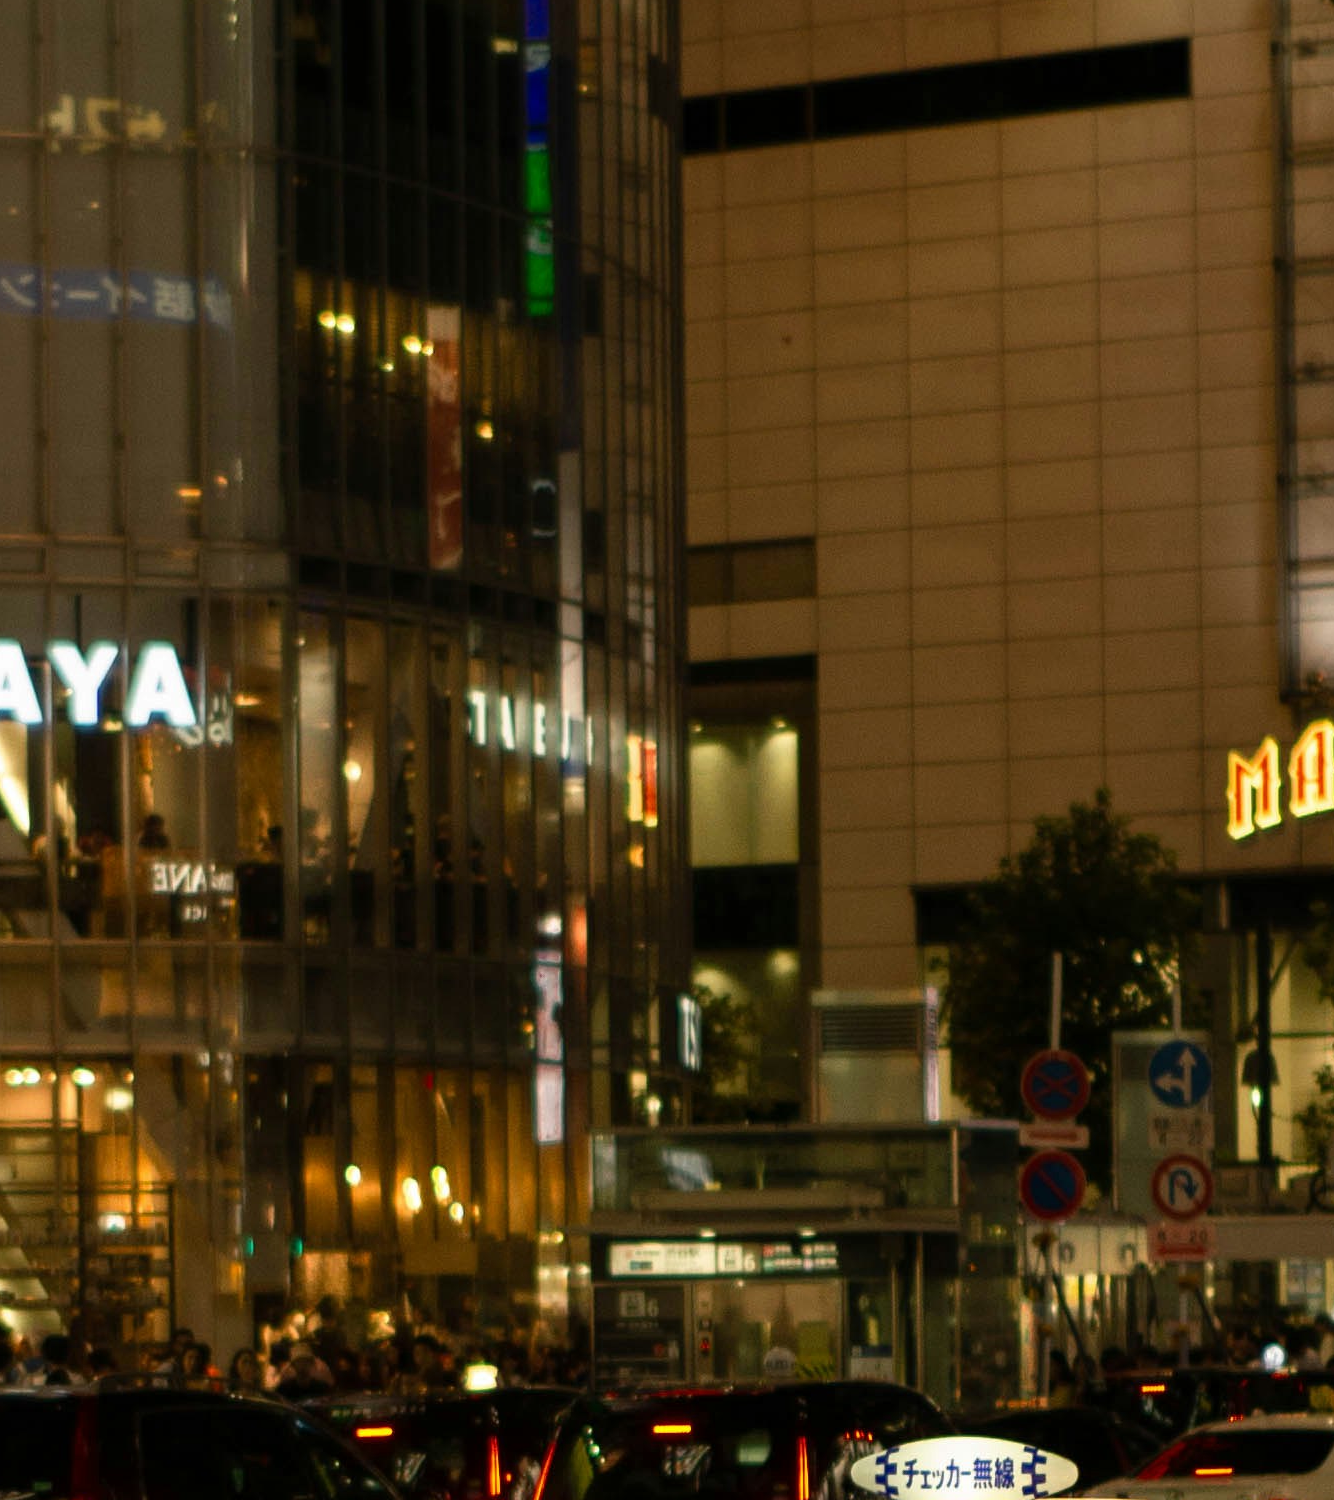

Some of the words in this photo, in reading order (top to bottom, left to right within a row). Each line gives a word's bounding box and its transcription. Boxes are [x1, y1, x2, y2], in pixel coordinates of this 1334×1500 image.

[902, 1457, 1015, 1490] チェッカー無線
